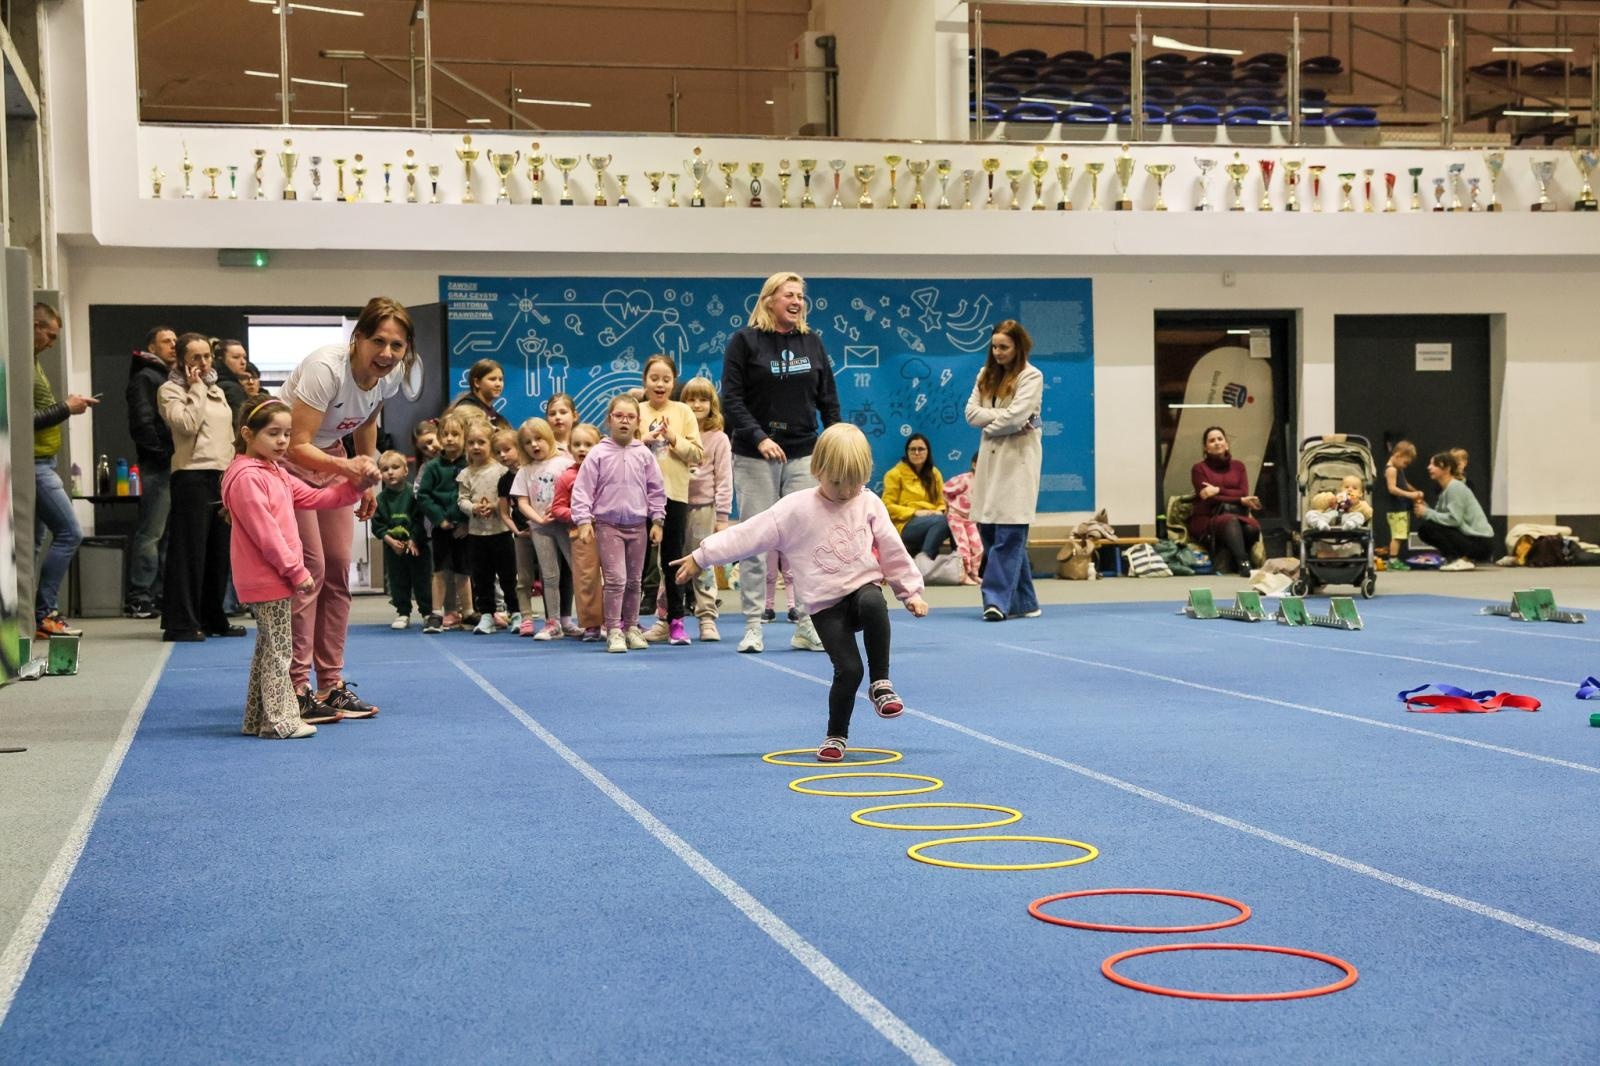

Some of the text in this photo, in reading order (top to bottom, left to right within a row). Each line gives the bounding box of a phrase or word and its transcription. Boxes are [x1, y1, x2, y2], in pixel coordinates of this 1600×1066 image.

[448, 282, 477, 290] ZAWSZE
[448, 292, 498, 300] GRAJ CZYSTO
[453, 302, 489, 310] HISTORIA
[448, 311, 494, 320] PRAWDZIWA
